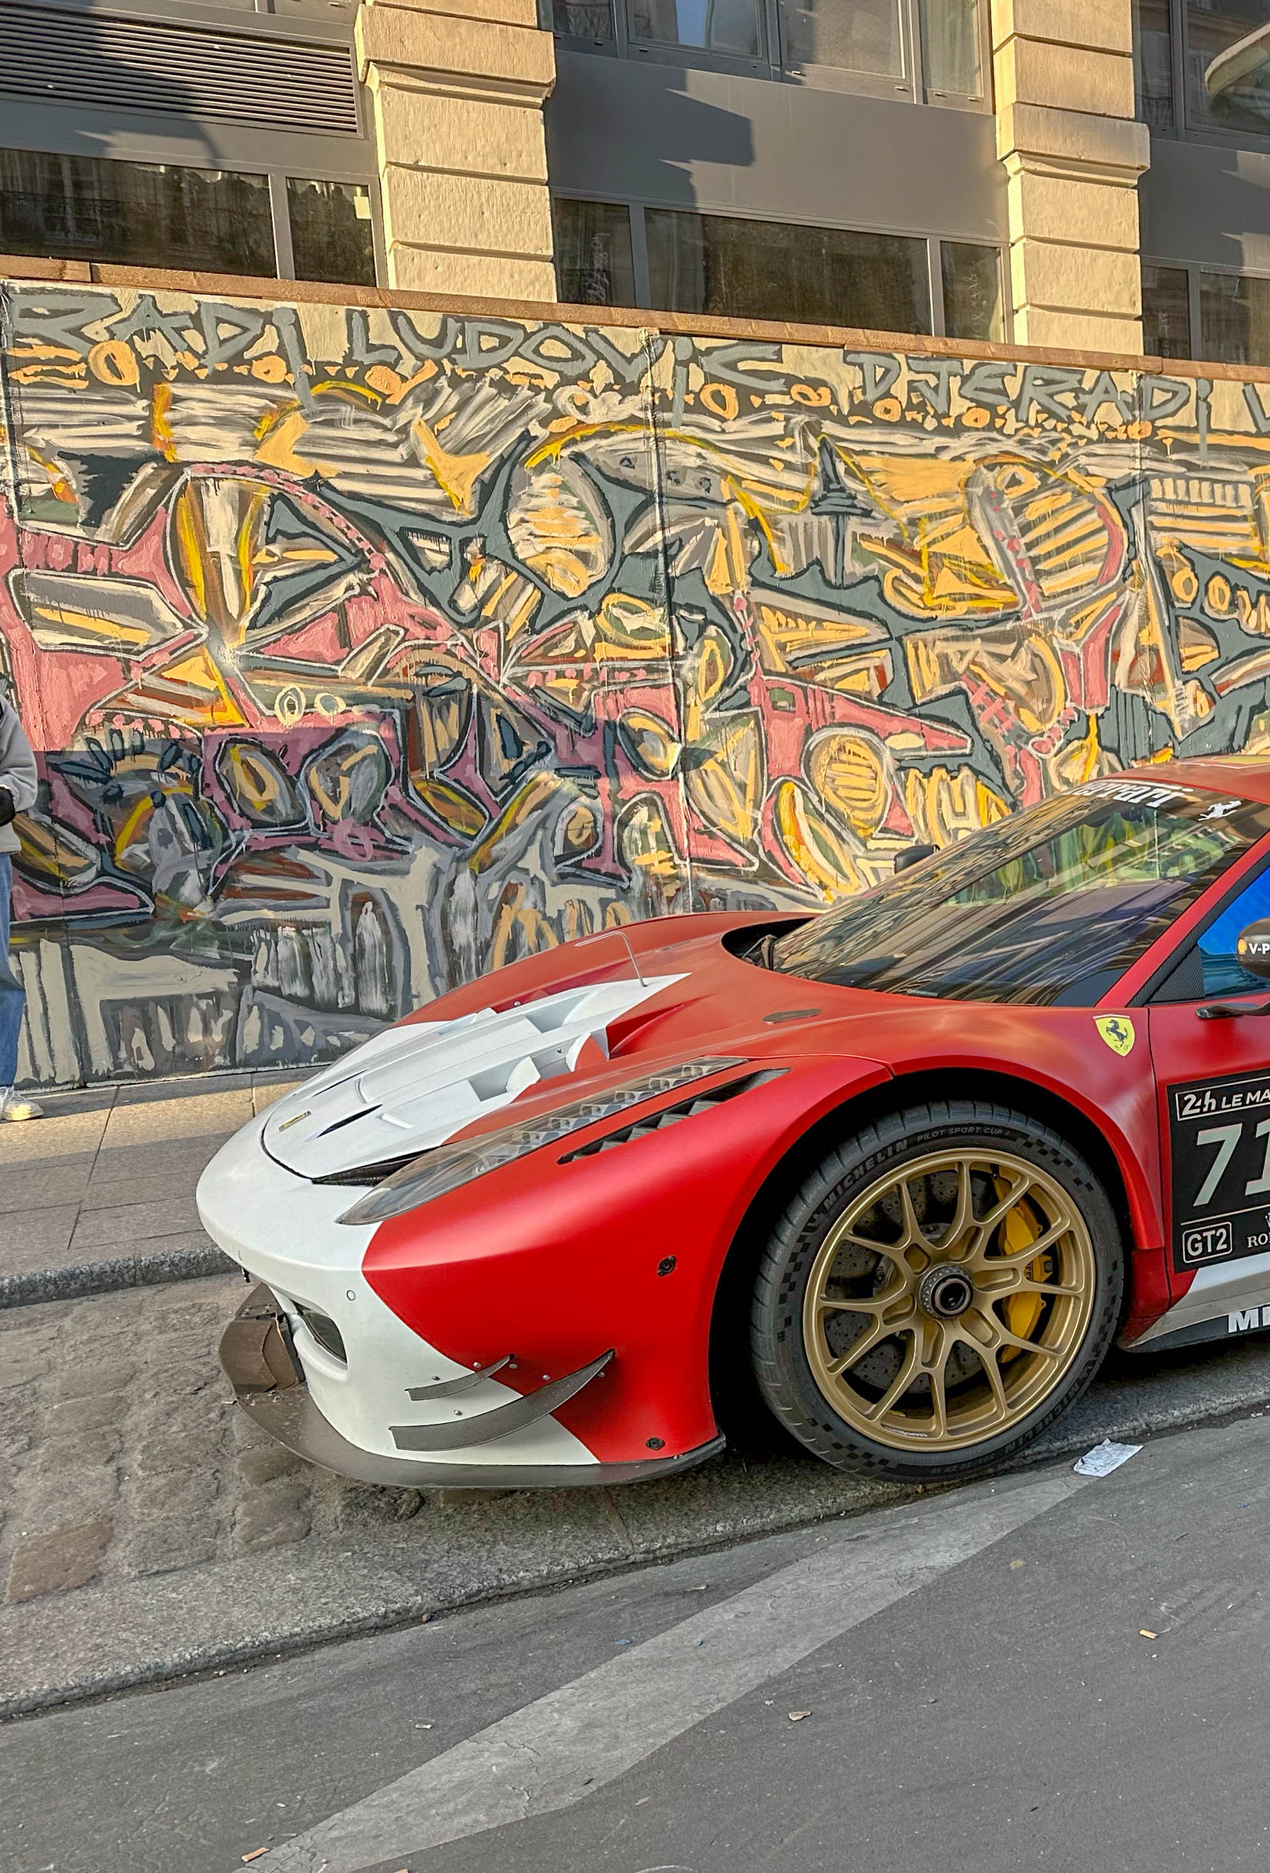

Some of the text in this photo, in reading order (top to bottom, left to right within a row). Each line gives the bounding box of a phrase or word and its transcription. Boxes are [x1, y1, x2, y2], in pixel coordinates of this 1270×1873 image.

[1221, 1093, 1243, 1109] LE
[917, 1130, 946, 1143] PILOT
[949, 1125, 983, 1136] SPORT
[984, 1126, 1003, 1136] CUP
[824, 1138, 909, 1211] MICHELIN
[1186, 1228, 1228, 1257] GT2
